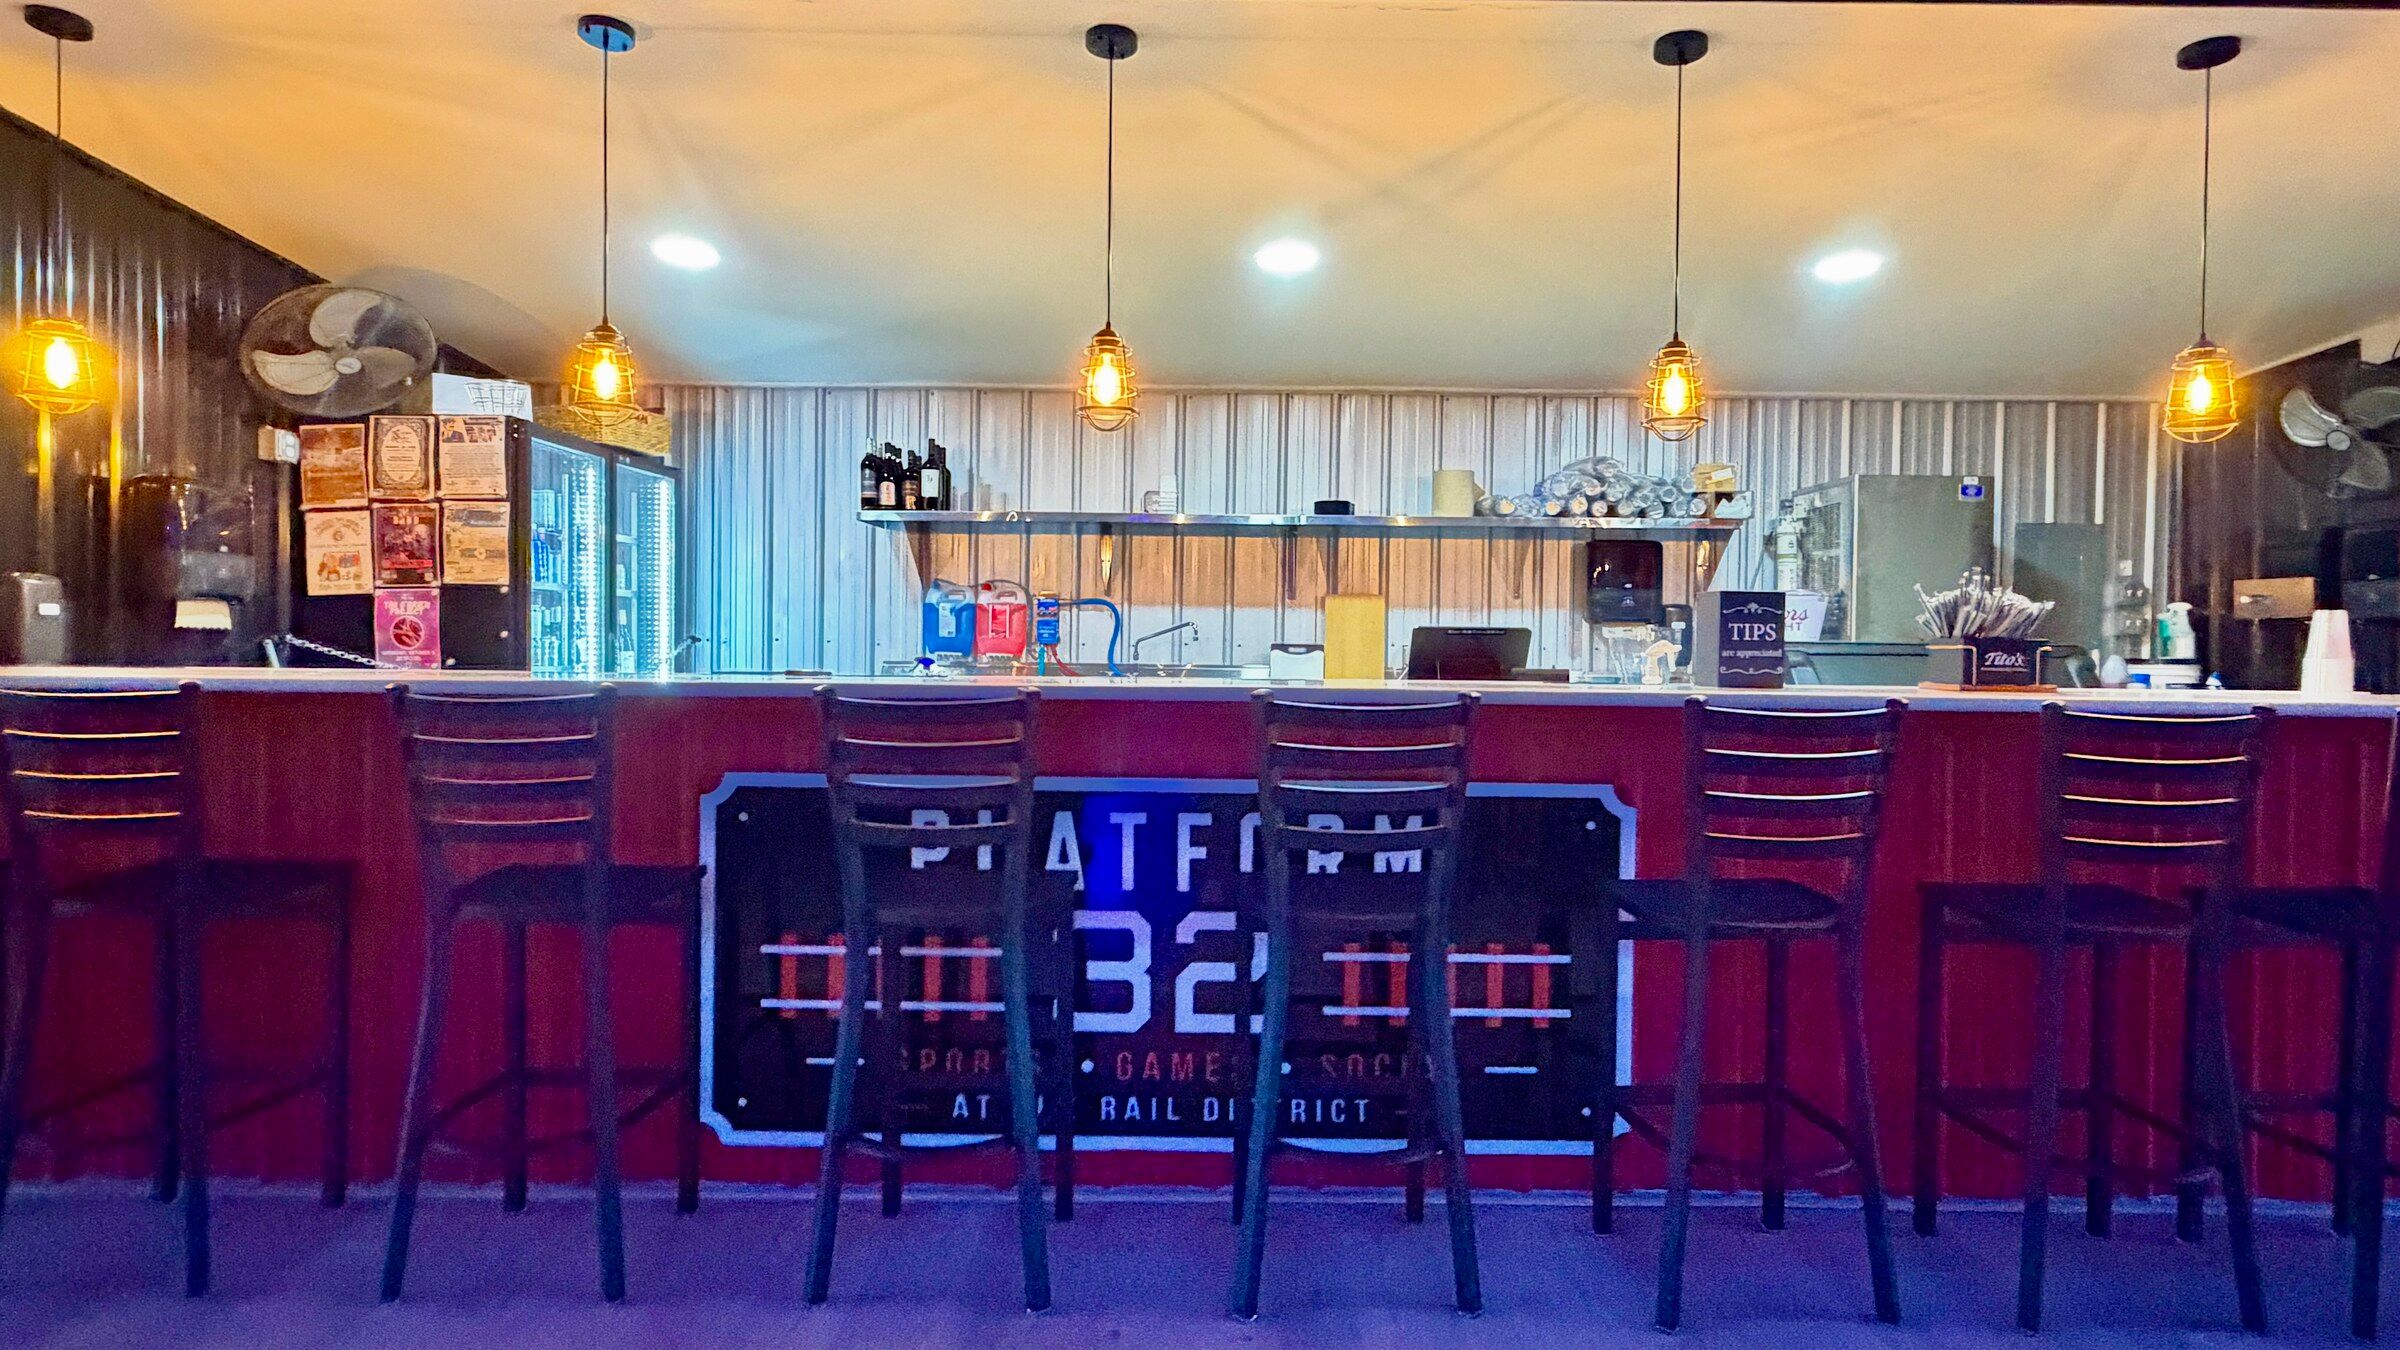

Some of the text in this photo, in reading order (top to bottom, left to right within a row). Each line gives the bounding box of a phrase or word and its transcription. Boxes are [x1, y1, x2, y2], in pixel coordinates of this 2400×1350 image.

[1728, 623, 1777, 641] TIPS
[1736, 649, 1783, 658] appreciated
[1984, 652, 2025, 666] Tito's
[1116, 1051, 1238, 1082] GAME
[952, 1093, 1370, 1123] AT RAIL DIRICT
